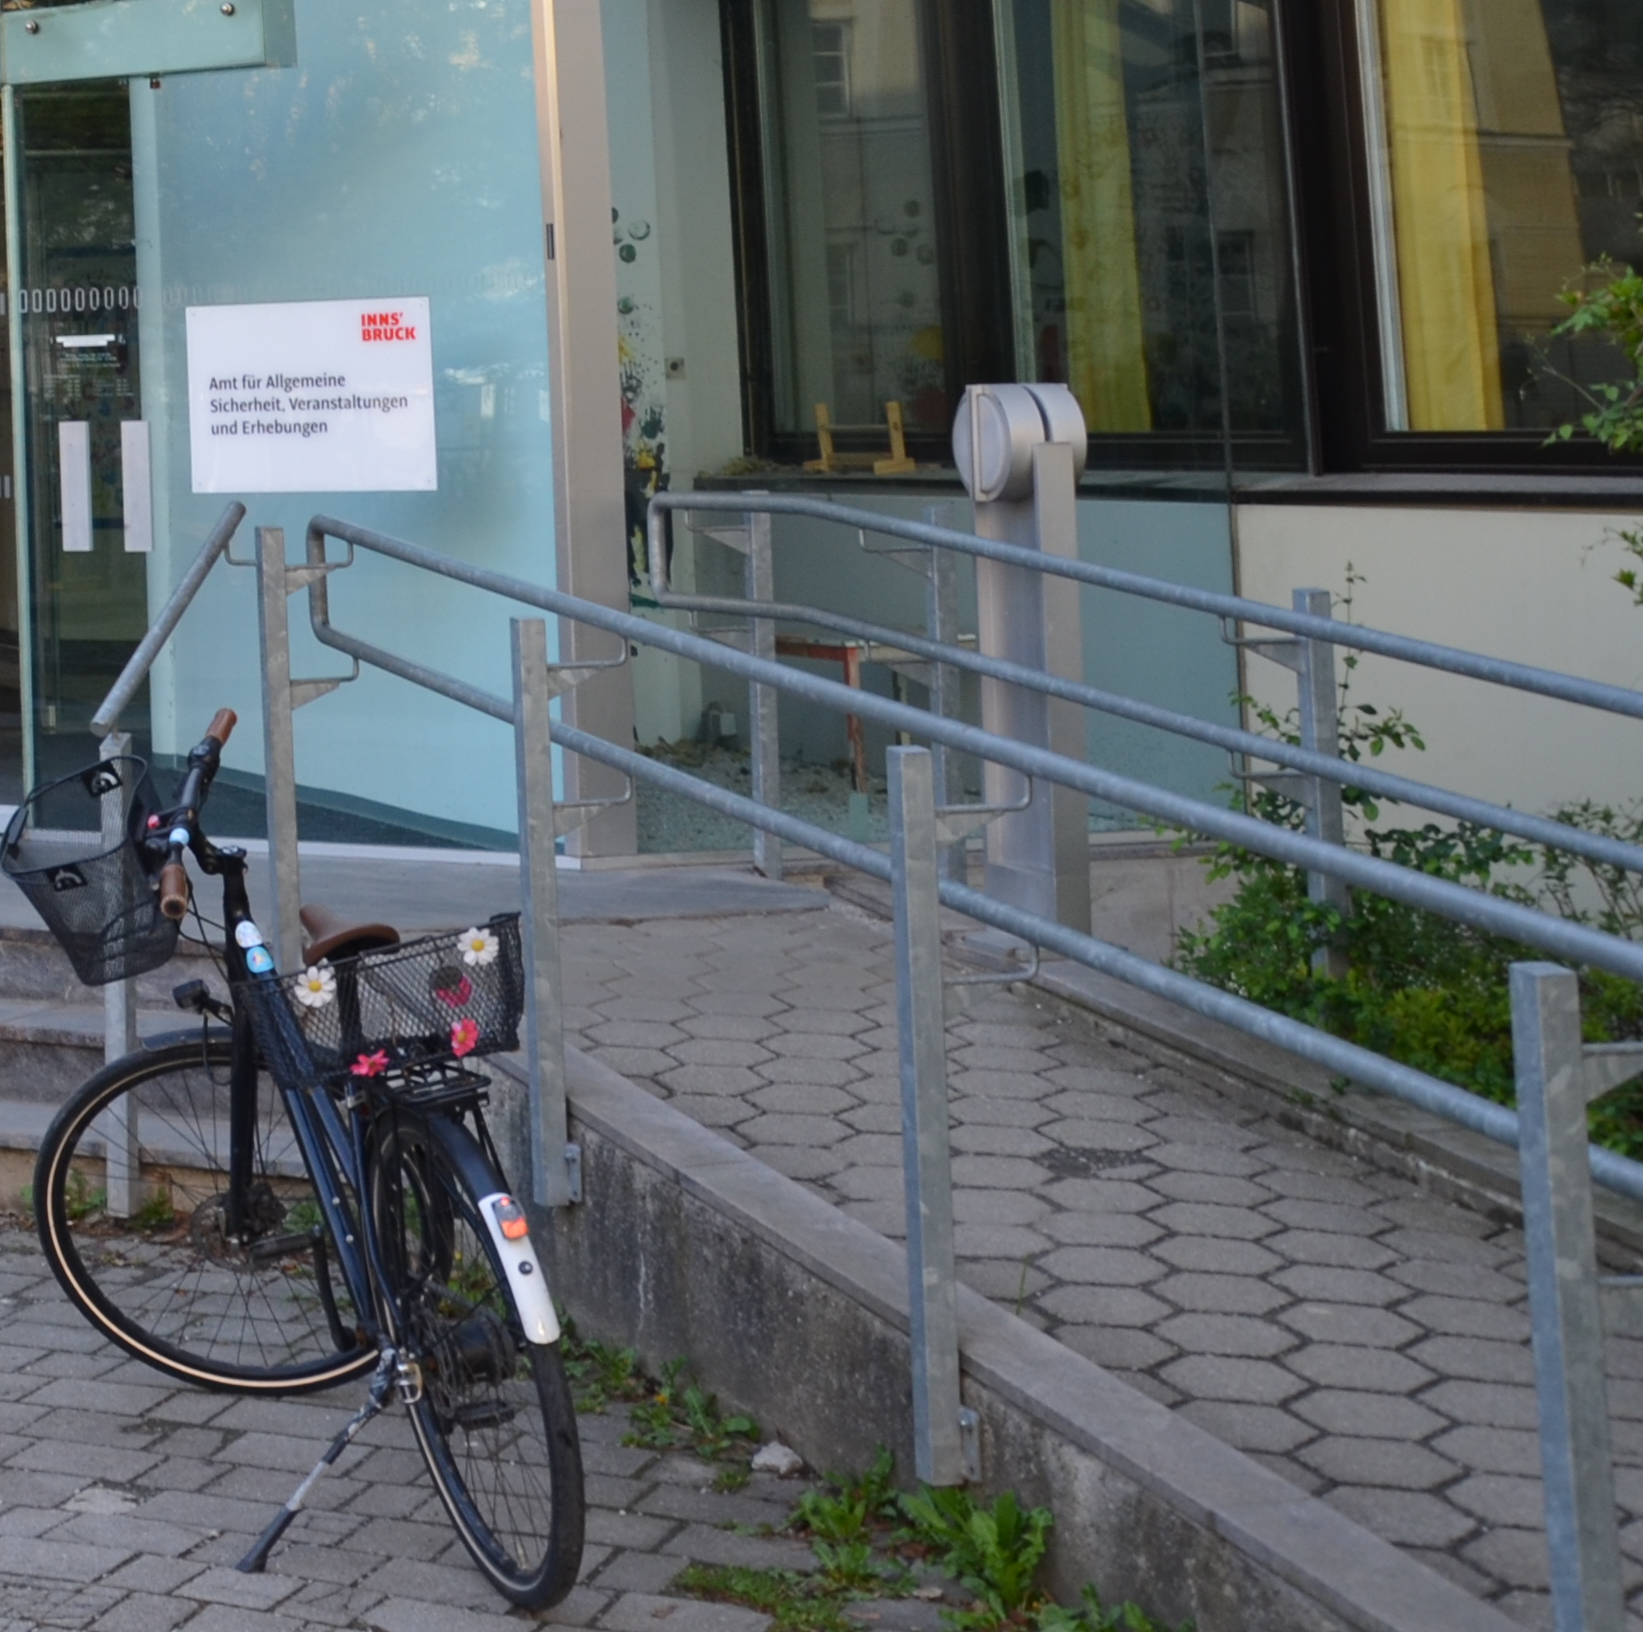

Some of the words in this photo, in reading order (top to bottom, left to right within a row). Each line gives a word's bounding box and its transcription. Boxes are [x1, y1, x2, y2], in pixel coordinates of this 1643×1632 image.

[362, 327, 416, 341] BRUCK
[209, 376, 238, 390] Amt
[242, 374, 262, 390] für
[266, 373, 346, 392] Allgemeine
[210, 397, 286, 413] Sicherheit,
[289, 394, 408, 413] Veranstaltungen
[211, 421, 238, 436] und
[242, 420, 328, 437] Erhebungen
